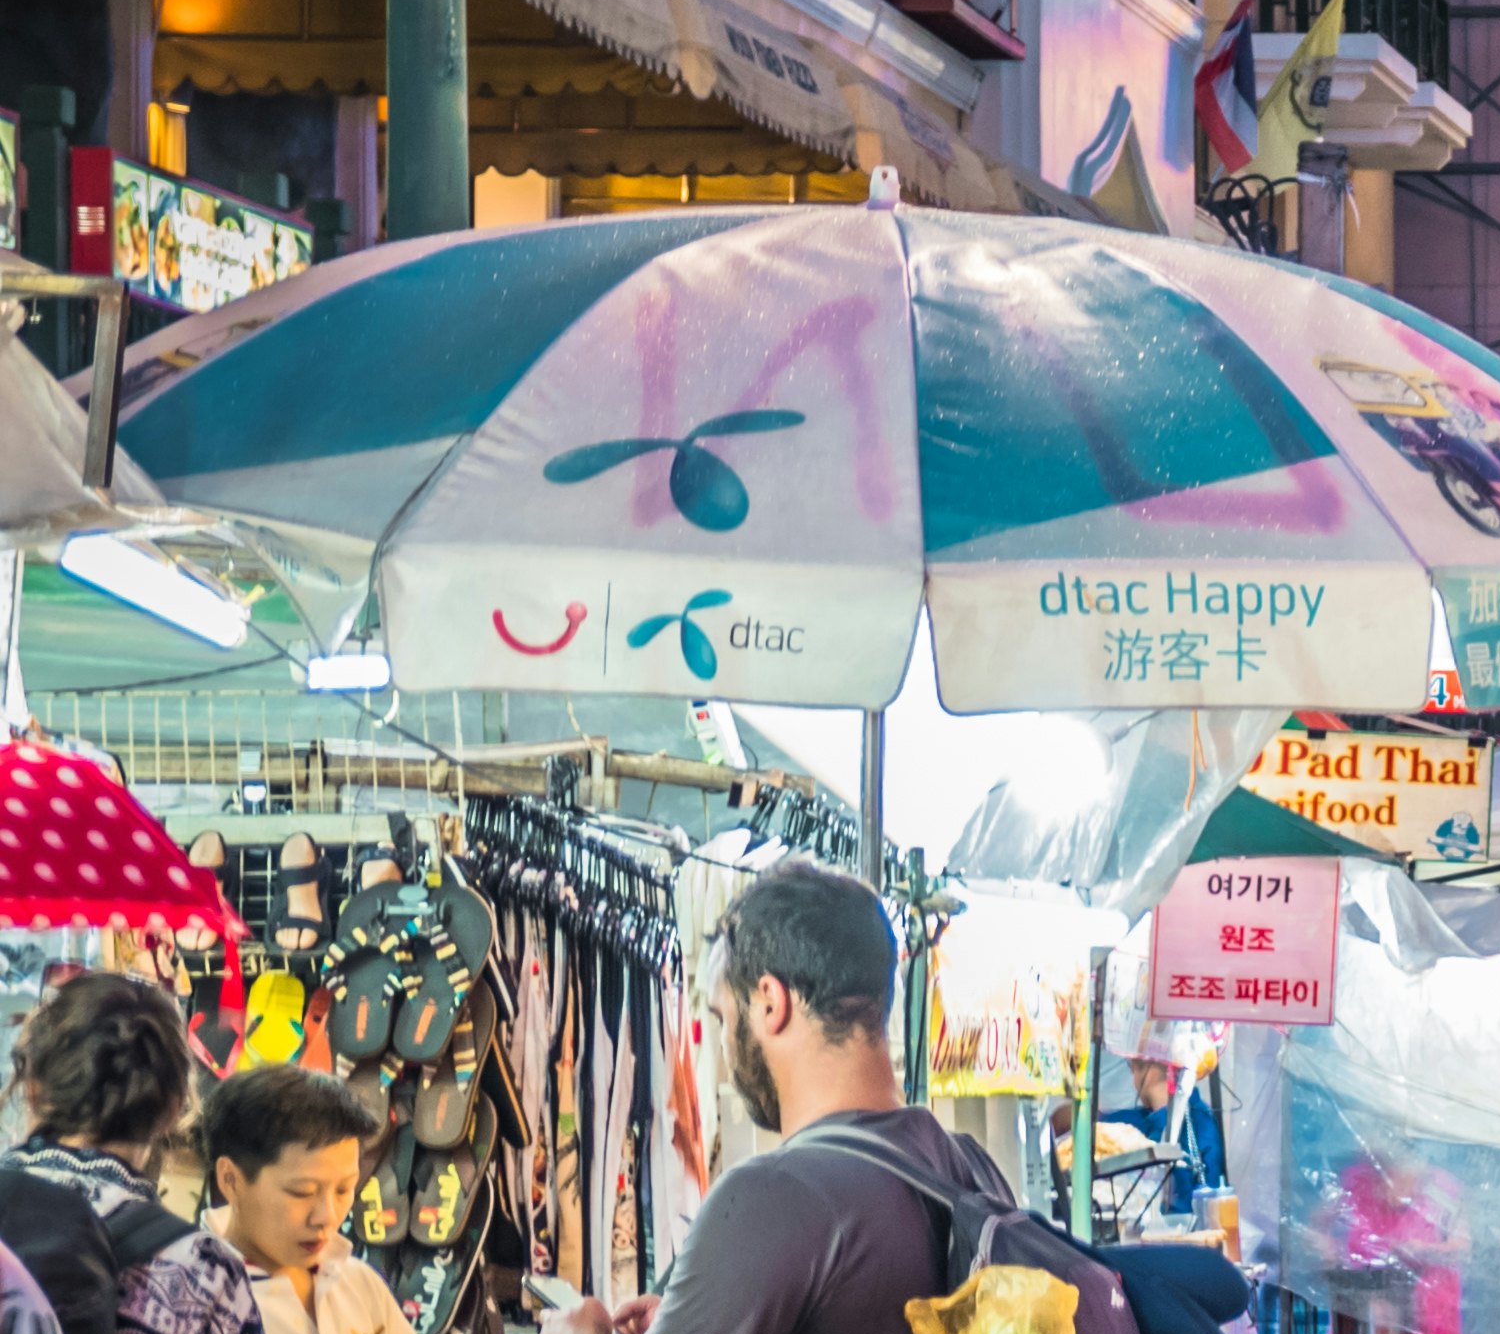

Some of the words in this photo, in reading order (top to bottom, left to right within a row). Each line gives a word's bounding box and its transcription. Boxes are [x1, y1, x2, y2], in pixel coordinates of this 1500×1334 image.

[1038, 570, 1148, 618] dtac
[1165, 570, 1326, 629] Happy
[728, 617, 806, 655] dtac
[1102, 628, 1268, 683] 游客卡
[1276, 738, 1362, 781] Pad
[1374, 744, 1478, 787] Thai
[1206, 872, 1294, 907] 여기가
[1217, 924, 1276, 955] 원조
[1167, 974, 1228, 1008] 조조
[1232, 975, 1320, 1009] 파타이
